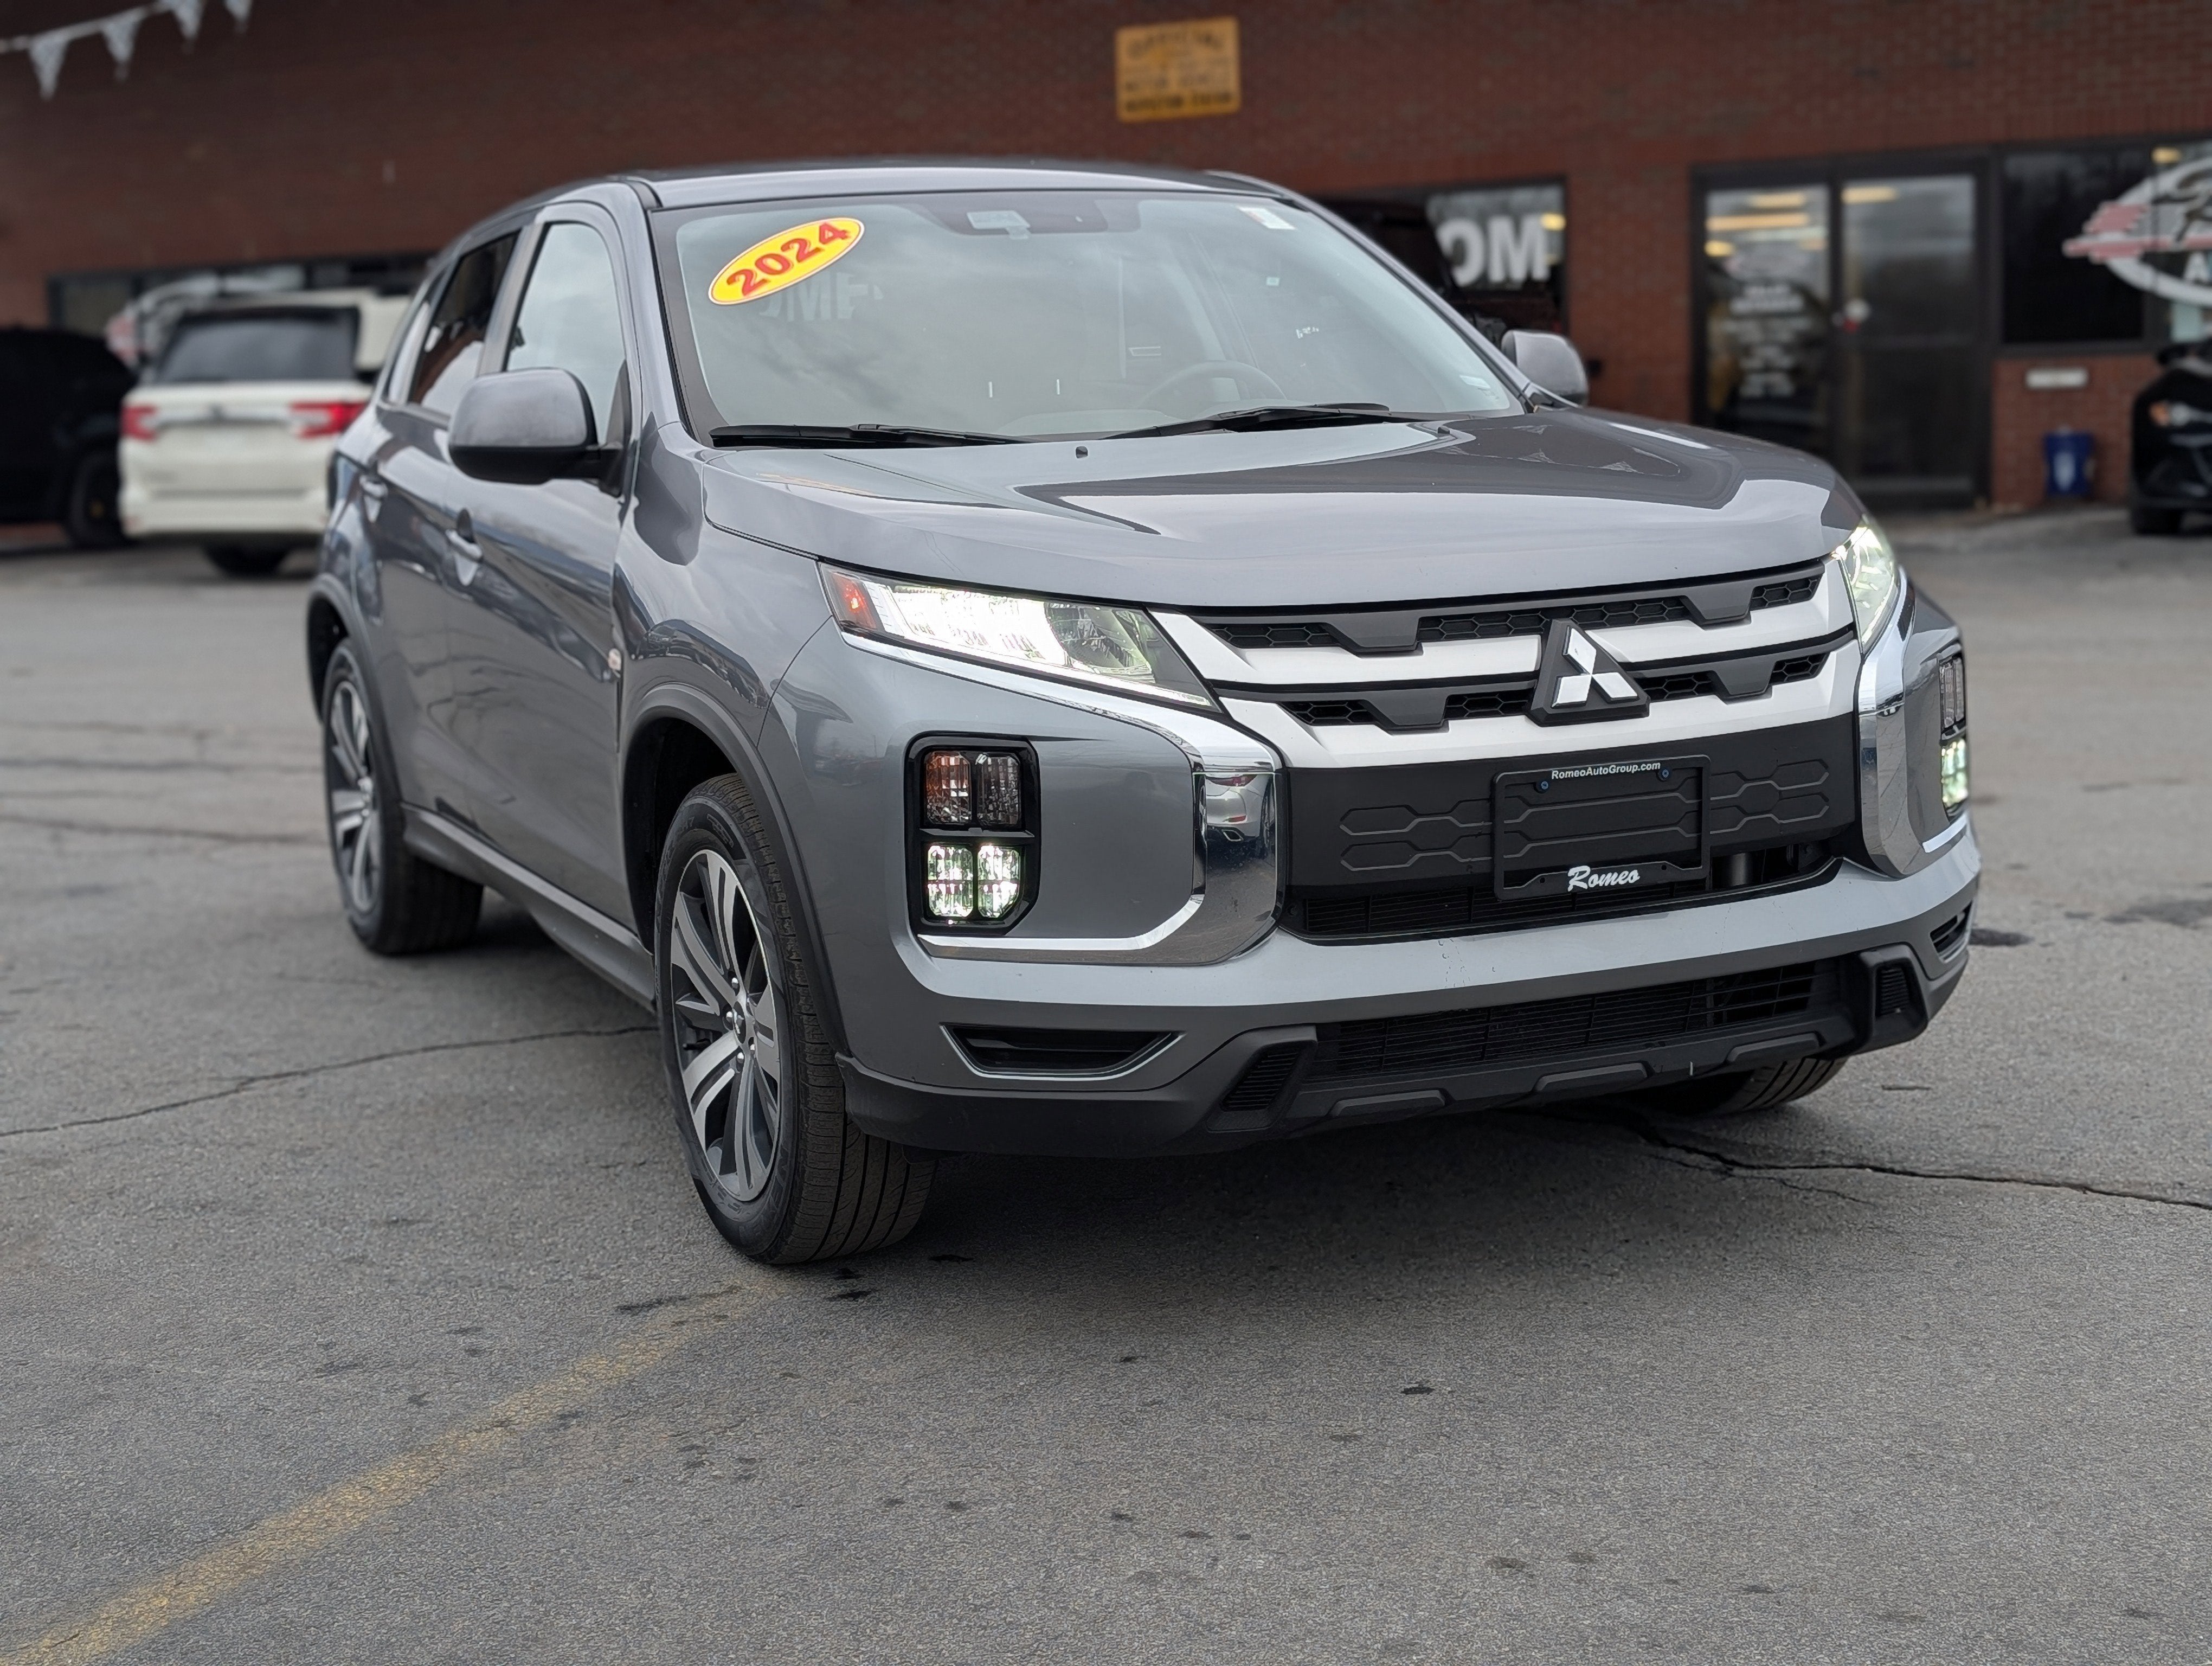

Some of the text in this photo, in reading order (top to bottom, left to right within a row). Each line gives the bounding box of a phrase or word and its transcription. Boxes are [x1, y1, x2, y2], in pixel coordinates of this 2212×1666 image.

[727, 223, 850, 296] 2024
[1552, 762, 1660, 779] RomeoAutoGroup.com
[1568, 866, 1640, 892] Romeo
